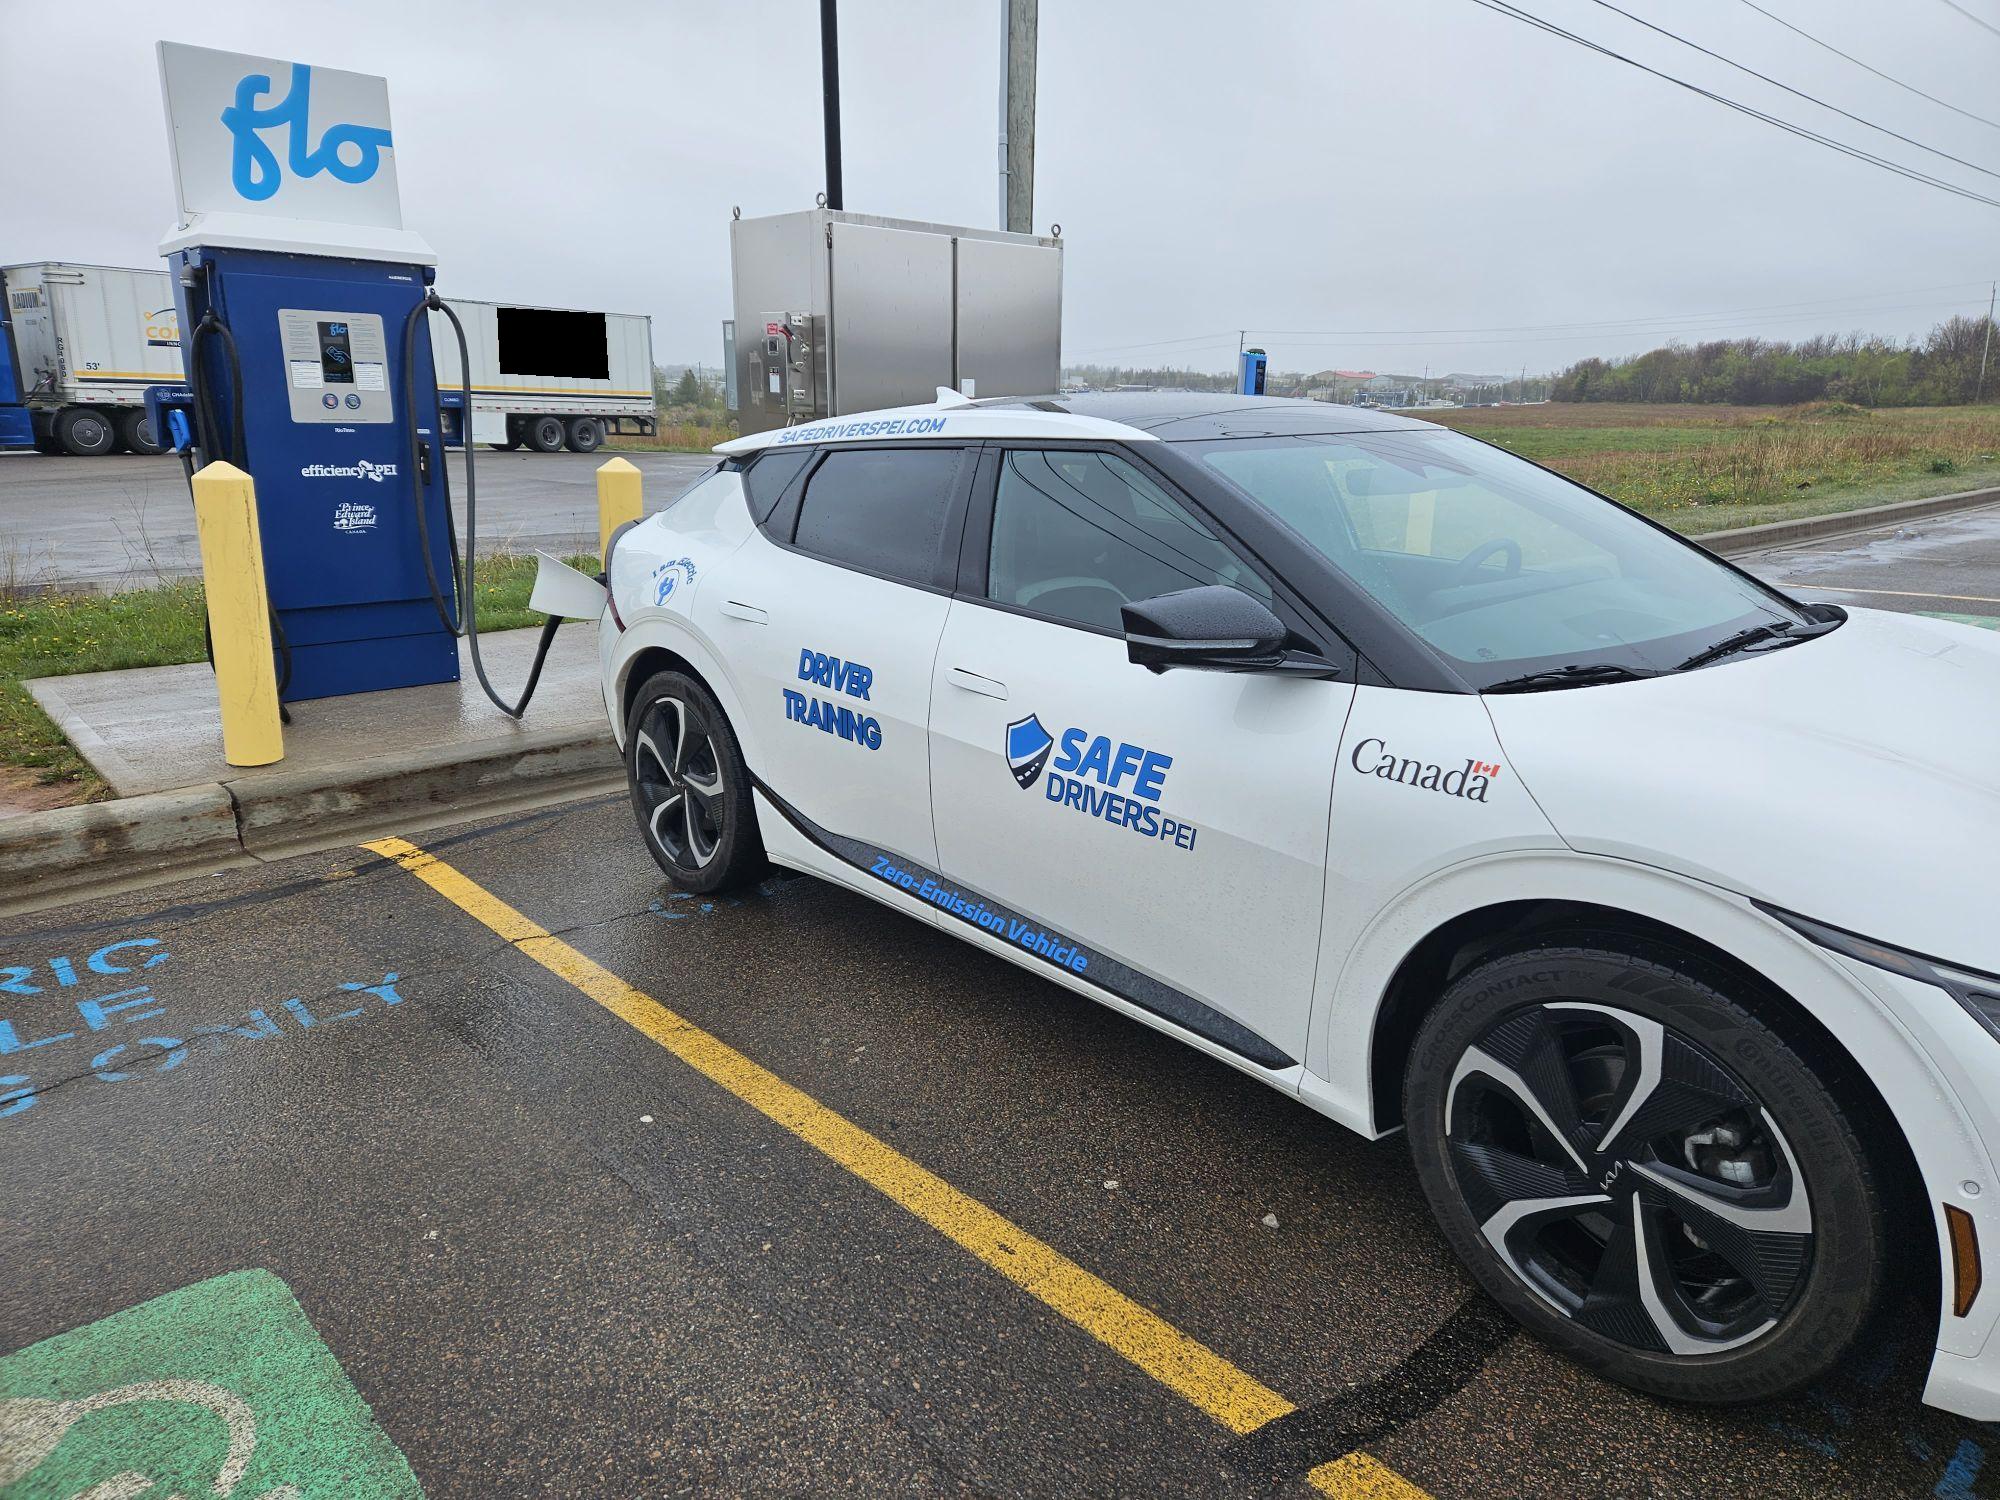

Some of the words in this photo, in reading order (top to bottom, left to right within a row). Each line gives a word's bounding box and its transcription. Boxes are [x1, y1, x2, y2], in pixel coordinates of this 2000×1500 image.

[220, 62, 393, 202] flo
[146, 326, 180, 339] CO
[778, 417, 947, 444] SAFEDRIVERSPEI.COM
[301, 464, 365, 479] efficiency
[374, 464, 398, 476] PEI
[334, 509, 372, 519] Edward
[338, 502, 374, 512] Prince
[348, 515, 376, 527] Island
[798, 648, 873, 702] DRIVER
[782, 687, 882, 751] TRAINING
[1053, 727, 1174, 802] SAFE
[1351, 738, 1490, 803] Canada
[870, 855, 1007, 935] Zero-Emission
[1007, 918, 1089, 974] Vehicle
